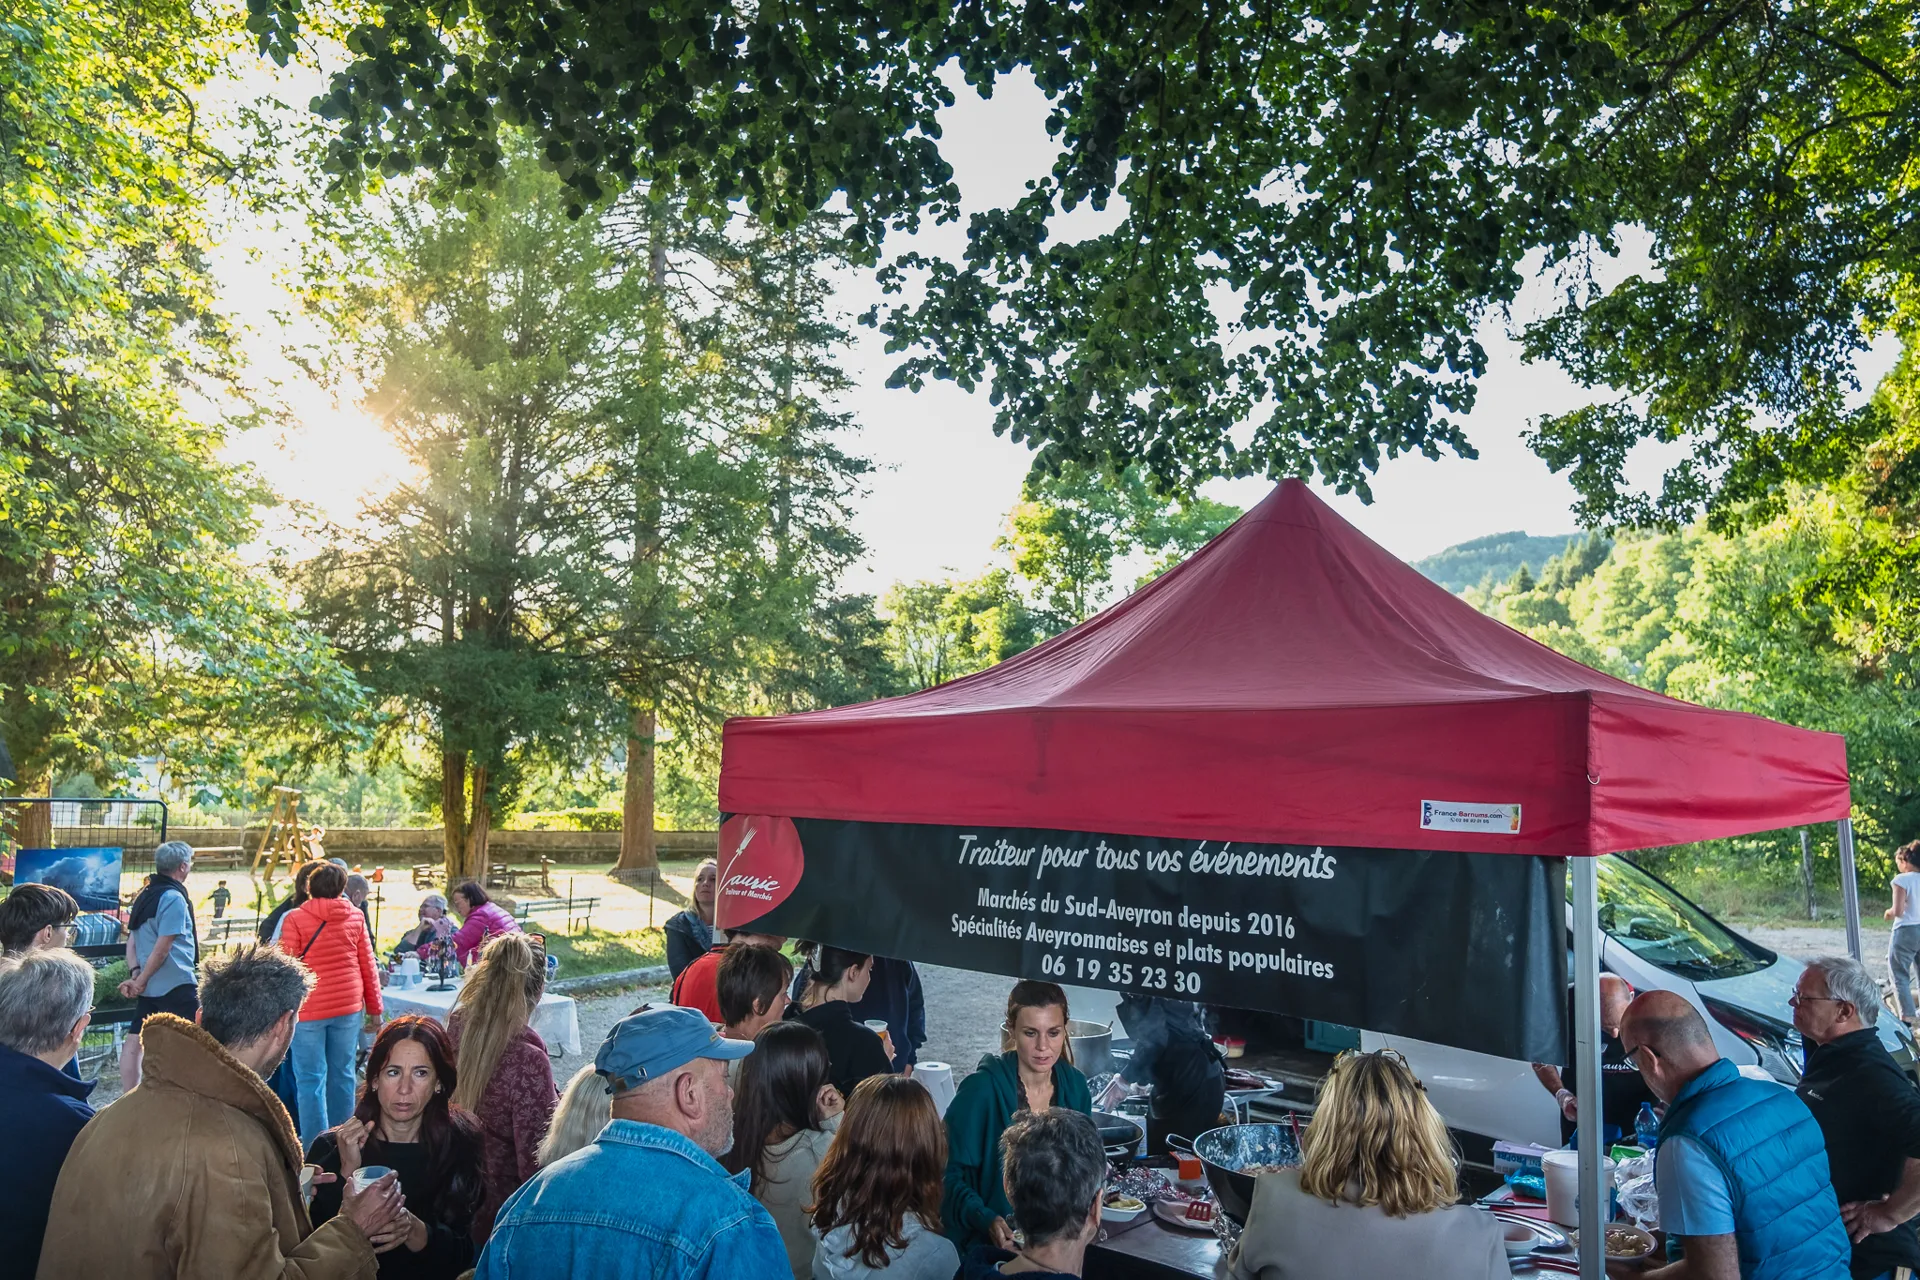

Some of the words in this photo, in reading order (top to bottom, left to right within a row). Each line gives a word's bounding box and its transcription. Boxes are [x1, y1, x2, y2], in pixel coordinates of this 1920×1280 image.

[1433, 809, 1457, 818] France
[958, 834, 1035, 867] Traiteur
[1036, 844, 1089, 880] pour
[1095, 840, 1141, 870] tous
[1146, 849, 1183, 872] vos
[1189, 840, 1337, 880] événements
[977, 887, 1036, 912] Marchés
[1040, 892, 1060, 914] du
[1064, 895, 1173, 927] Sud-Aveyron
[1177, 905, 1241, 934] depuis
[1247, 912, 1296, 939] 2016
[951, 913, 1022, 940] Spécialités
[1025, 922, 1148, 956] Aveyronnaises
[1153, 939, 1171, 958] et
[1176, 938, 1223, 964] plats
[1228, 948, 1334, 979] populaires
[1041, 954, 1066, 976] 06
[1076, 957, 1101, 980] 19
[1108, 962, 1133, 985] 35
[1141, 966, 1167, 989] 23
[1173, 970, 1201, 994] 30
[1602, 1063, 1631, 1071] auri
